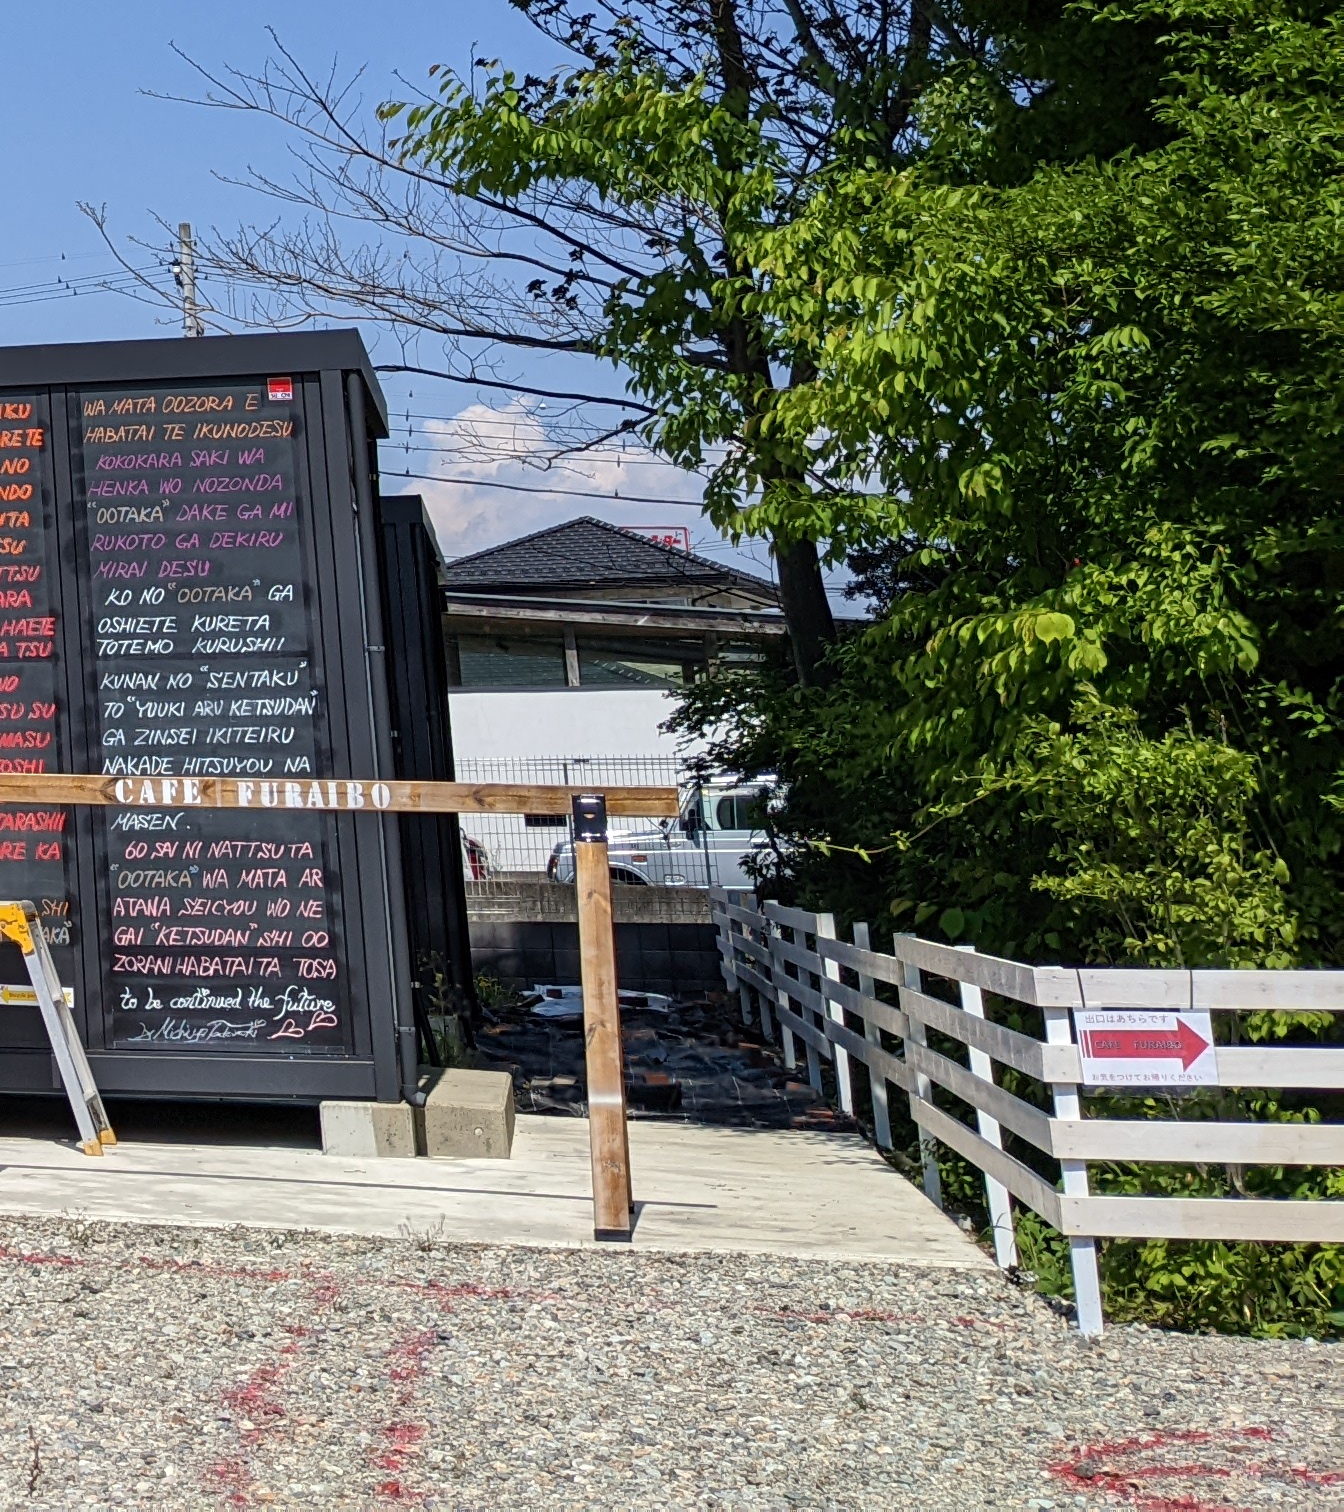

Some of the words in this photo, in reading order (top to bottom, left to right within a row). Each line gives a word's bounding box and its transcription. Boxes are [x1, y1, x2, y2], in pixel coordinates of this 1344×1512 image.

[84, 400, 105, 417] WA
[109, 396, 155, 415] MATA
[162, 396, 233, 413] OOZORA
[245, 394, 258, 410] E
[88, 480, 149, 497] HENKA
[159, 479, 181, 495] WO
[193, 474, 282, 493] NOZONDA
[94, 561, 148, 579] MIRAI
[159, 561, 211, 578] DESU
[98, 617, 177, 633] OSHIETE
[191, 615, 270, 632] KURETA
[97, 639, 173, 656] TOTEMO
[192, 638, 284, 653] KURUSHII
[102, 729, 125, 746] GA
[134, 728, 196, 745] ZINSEI
[207, 727, 294, 744] IKITEIRU
[102, 757, 173, 775] NAKADE
[182, 757, 273, 774] HITSUYOU
[284, 757, 311, 773] NA
[114, 779, 202, 804] CAFE
[237, 781, 390, 809] FURAIBO
[125, 842, 147, 859] 60
[150, 842, 178, 859] SAI
[183, 842, 202, 859] NI
[208, 842, 313, 859] NATTSUTA
[202, 869, 229, 888] WA
[237, 869, 287, 888] MATA
[299, 869, 323, 887] AR
[120, 988, 137, 1009] to
[148, 988, 163, 1009] be
[171, 988, 242, 1010] continued
[248, 986, 273, 1008] the
[273, 985, 335, 1020] future
[1085, 1014, 1168, 1024] 出口はあちらです
